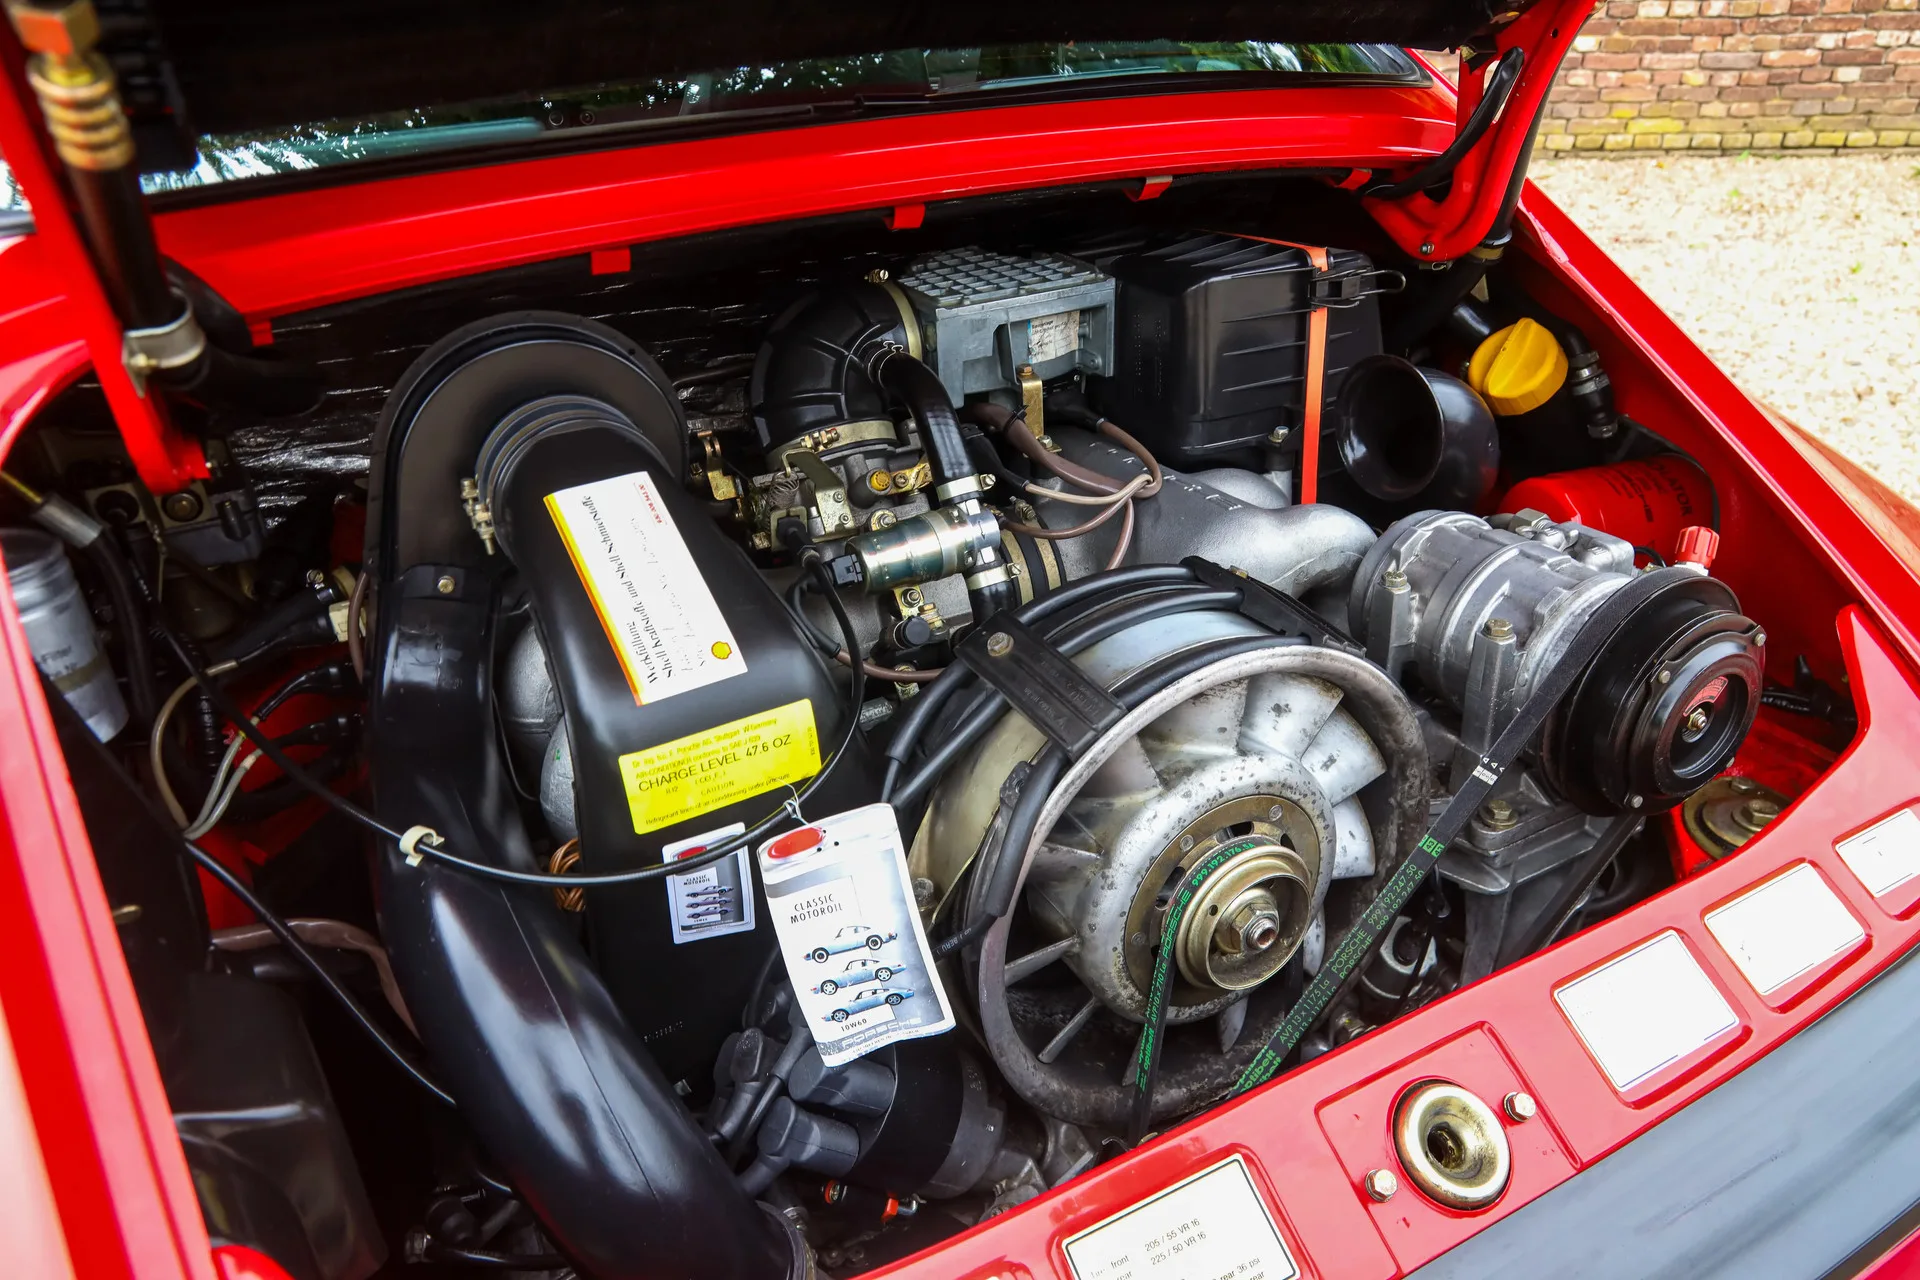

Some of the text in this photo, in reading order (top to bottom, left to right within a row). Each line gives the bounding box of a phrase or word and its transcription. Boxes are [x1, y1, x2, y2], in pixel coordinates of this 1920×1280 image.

[608, 553, 628, 579] Shell
[621, 579, 638, 599] und
[654, 649, 676, 678] Shell
[638, 766, 697, 792] CHARGE
[701, 752, 740, 773] LEVEL
[746, 743, 769, 758] 47.6
[773, 734, 791, 749] OZ
[701, 781, 735, 795] CAUTION
[766, 774, 790, 787] presure
[789, 902, 842, 923] MOTOROIL
[793, 893, 833, 912] CLASSIC
[941, 936, 958, 951] BERU
[1142, 1026, 1154, 1070] optibelt
[1162, 888, 1192, 959] PORSCHE
[1277, 1024, 1295, 1044] AVP
[1302, 988, 1322, 1010] 1175
[1318, 977, 1330, 990] La
[1329, 927, 1368, 974] PORSCHE
[840, 1017, 867, 1031] 10W60
[1110, 1255, 1129, 1268] front
[1144, 1238, 1160, 1251] 205
[1166, 1229, 1177, 1240] 55
[1177, 1222, 1190, 1233] VR
[1191, 1217, 1200, 1227] 16
[1150, 1252, 1166, 1265] 225
[1172, 1242, 1183, 1253] 50
[1183, 1235, 1196, 1246] VR
[1197, 1230, 1206, 1240] 16
[1236, 1262, 1247, 1273] 36
